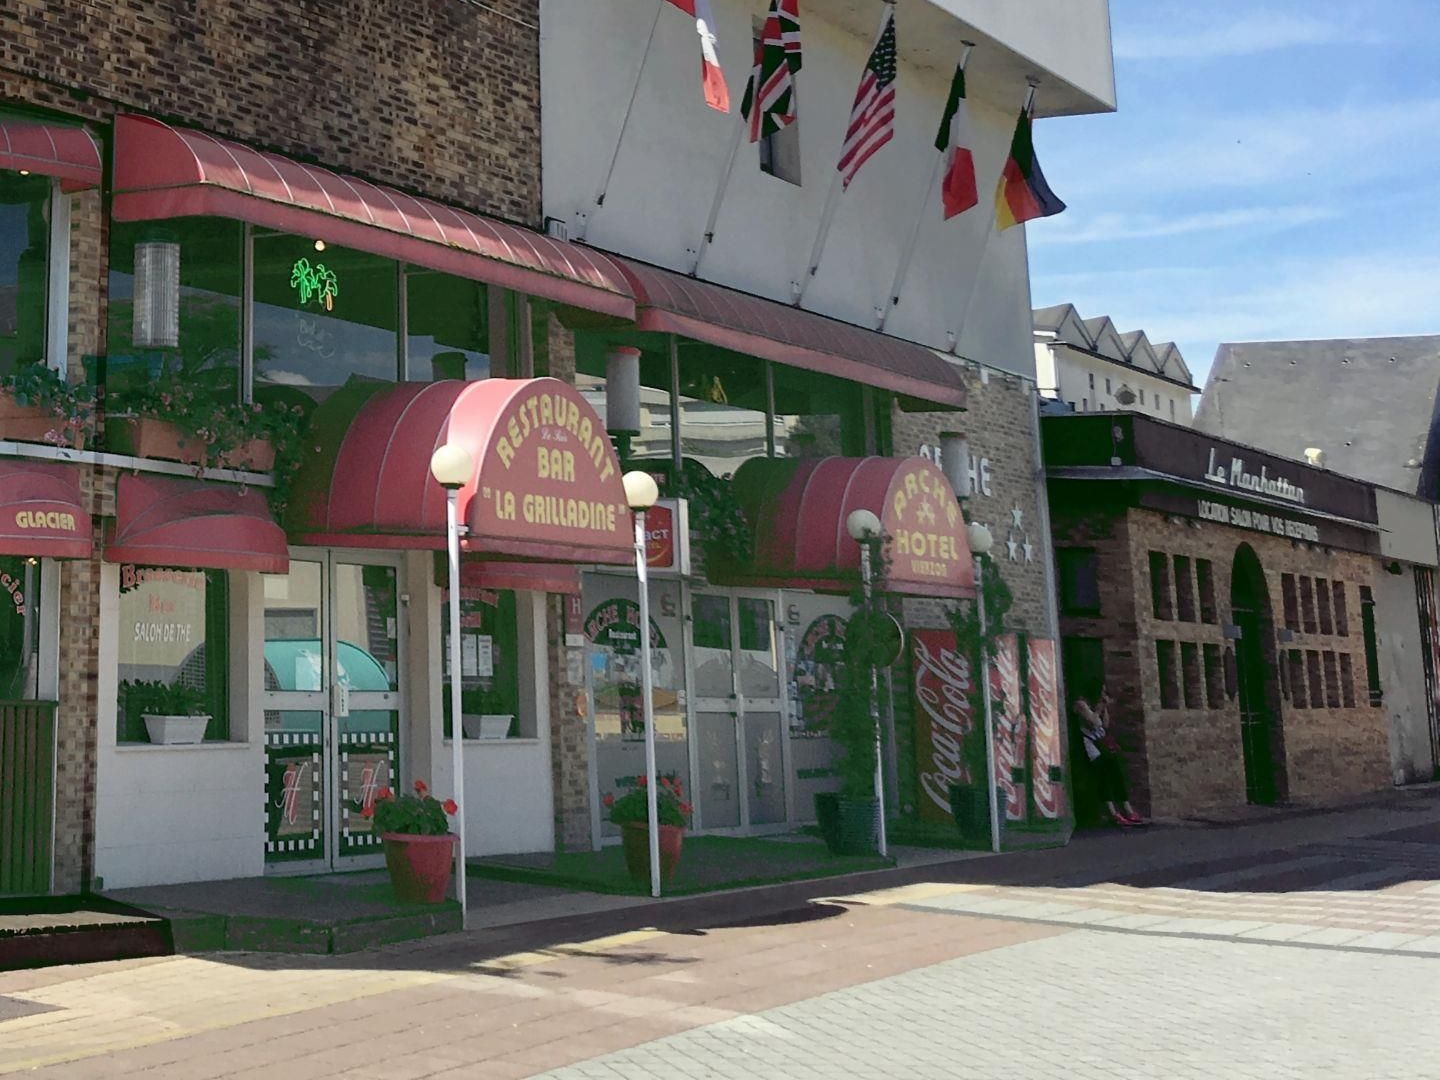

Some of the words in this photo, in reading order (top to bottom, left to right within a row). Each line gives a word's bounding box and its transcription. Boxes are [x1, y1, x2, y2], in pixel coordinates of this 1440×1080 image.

[496, 393, 615, 482] RESTAURANT
[537, 446, 575, 482] BAR
[1230, 457, 1306, 504] Manhattan
[894, 469, 958, 529] ARCHE
[15, 511, 76, 531] GLACIER
[896, 529, 959, 561] HOTEL
[134, 621, 161, 642] SALON
[163, 622, 176, 642] DE
[176, 623, 192, 643] THE
